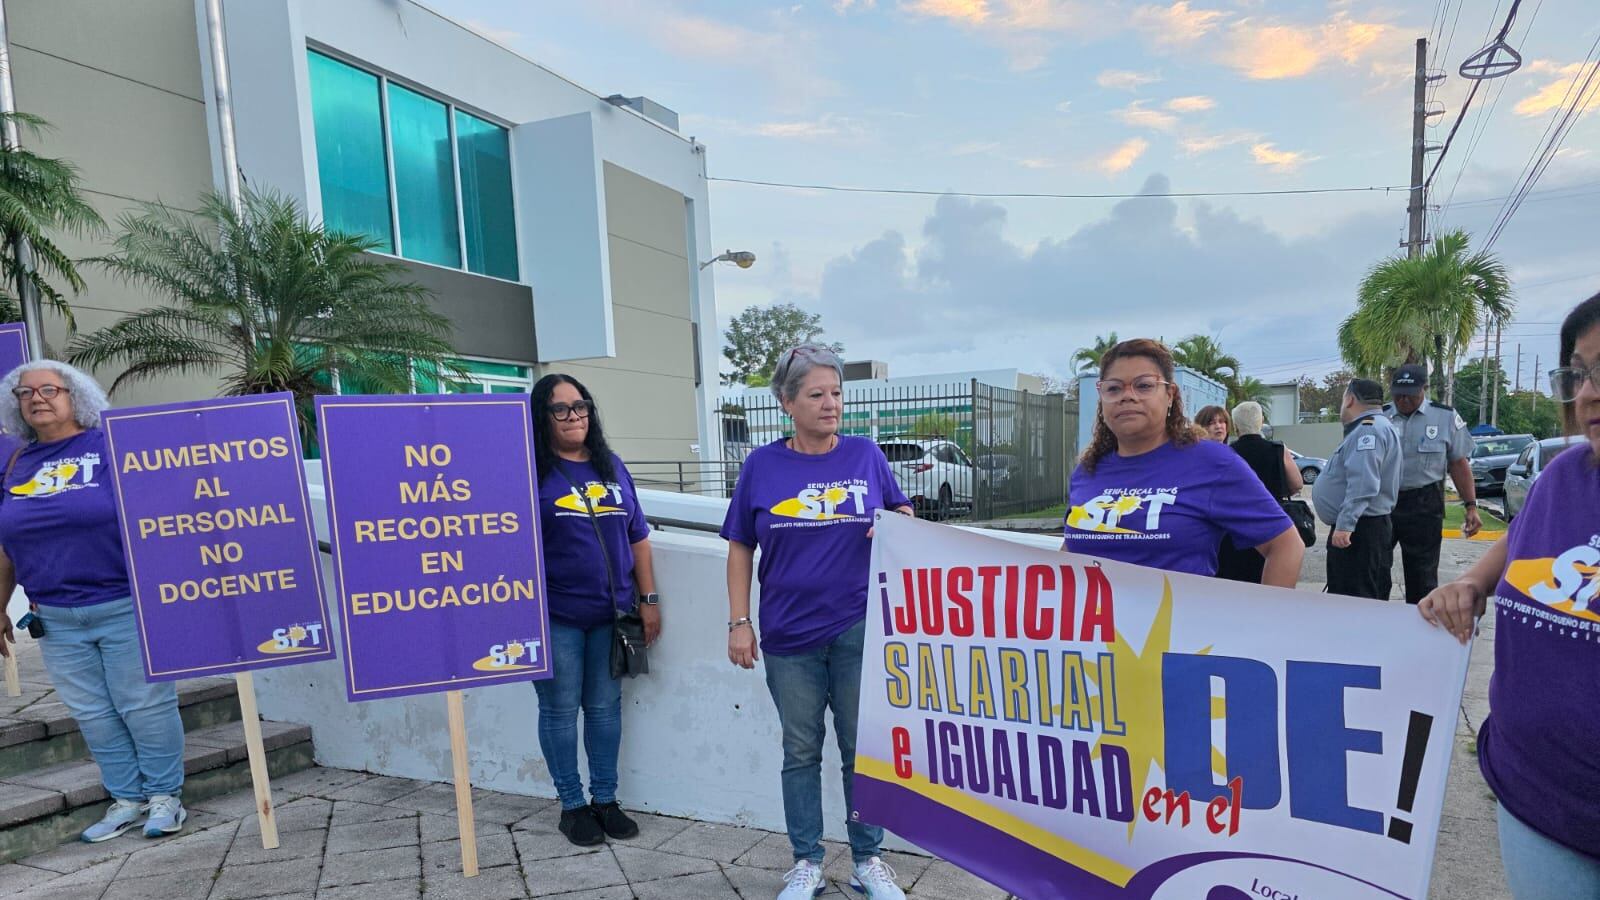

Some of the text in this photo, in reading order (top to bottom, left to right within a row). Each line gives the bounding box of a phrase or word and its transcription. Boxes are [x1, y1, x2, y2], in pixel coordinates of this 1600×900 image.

[123, 436, 289, 474] AUMENTOS
[404, 443, 452, 468] NO
[194, 477, 230, 500] AL
[399, 473, 472, 504] MÁS
[797, 484, 868, 520] SPT
[138, 503, 296, 540] PERSONAL
[354, 511, 520, 543] RECORTES
[1076, 492, 1177, 531] SPT
[199, 542, 244, 566] NO
[421, 550, 464, 575] EN
[159, 568, 297, 604] DOCENTE
[351, 575, 536, 616] EDUCACIÓN
[878, 564, 1116, 643] ¡JUSTICIA
[272, 624, 322, 651] SPT
[1579, 621, 1590, 630] DE
[489, 640, 541, 668] SPT
[884, 642, 1127, 737] SALARIAL
[892, 718, 1135, 823] e IGUALDAD
[1142, 776, 1243, 837] en el
